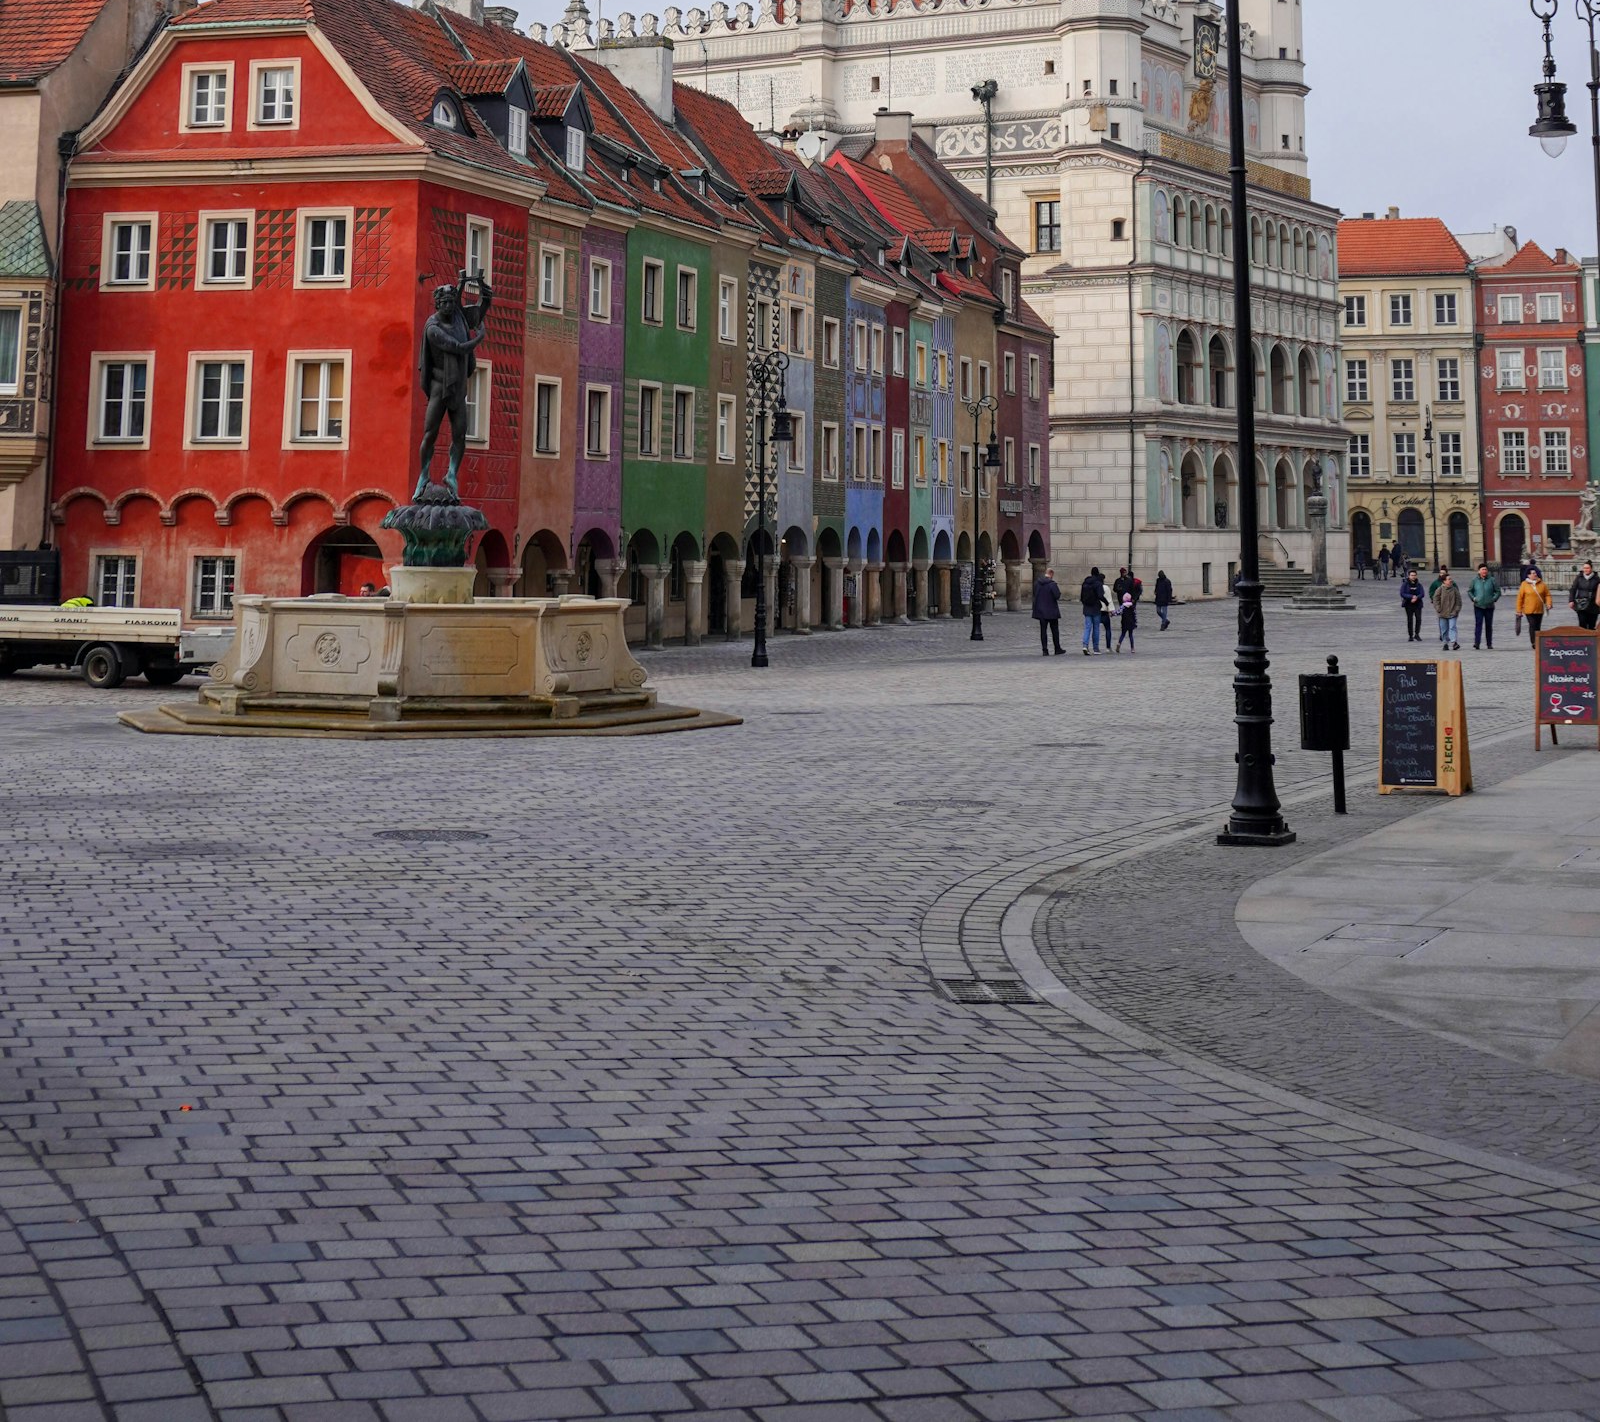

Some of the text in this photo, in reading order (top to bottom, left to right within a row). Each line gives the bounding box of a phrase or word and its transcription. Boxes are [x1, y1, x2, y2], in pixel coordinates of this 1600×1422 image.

[1391, 494, 1466, 506] Cocktail Bar
[1397, 673, 1418, 688] Pub
[1386, 687, 1433, 704] Columbus
[1444, 736, 1454, 764] LECH
